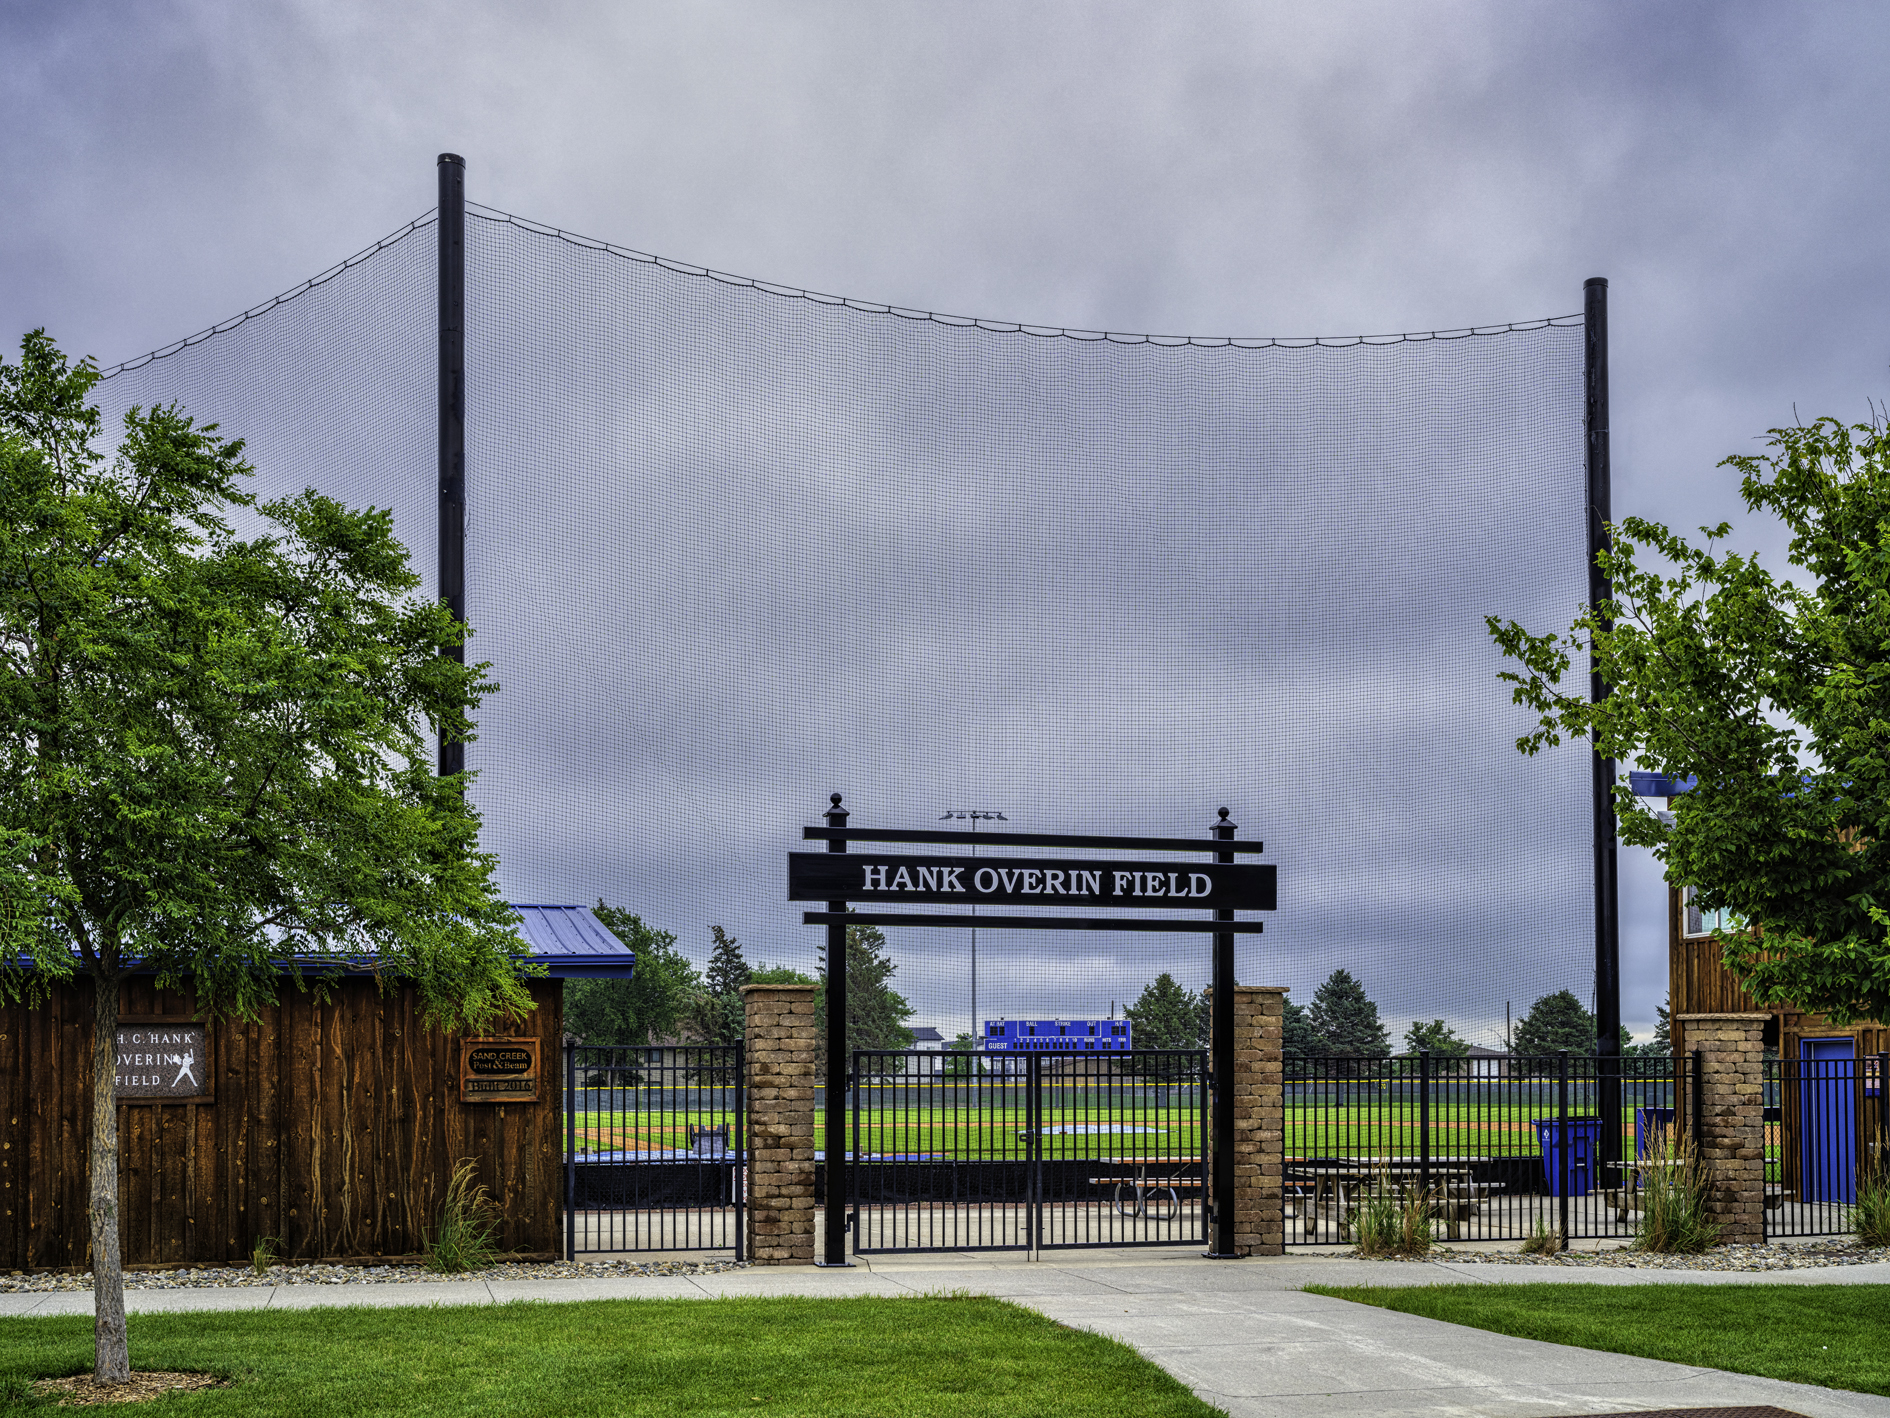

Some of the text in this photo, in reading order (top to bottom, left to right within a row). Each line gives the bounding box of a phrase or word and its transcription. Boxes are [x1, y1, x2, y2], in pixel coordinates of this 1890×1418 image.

[862, 865, 1213, 898] HANK OVERIN FIELD
[499, 1052, 528, 1060] CREEK
[492, 1058, 504, 1069] &
[504, 1061, 528, 1069] Beam
[115, 1075, 160, 1085] FIELD
[503, 1081, 532, 1091] 2016
